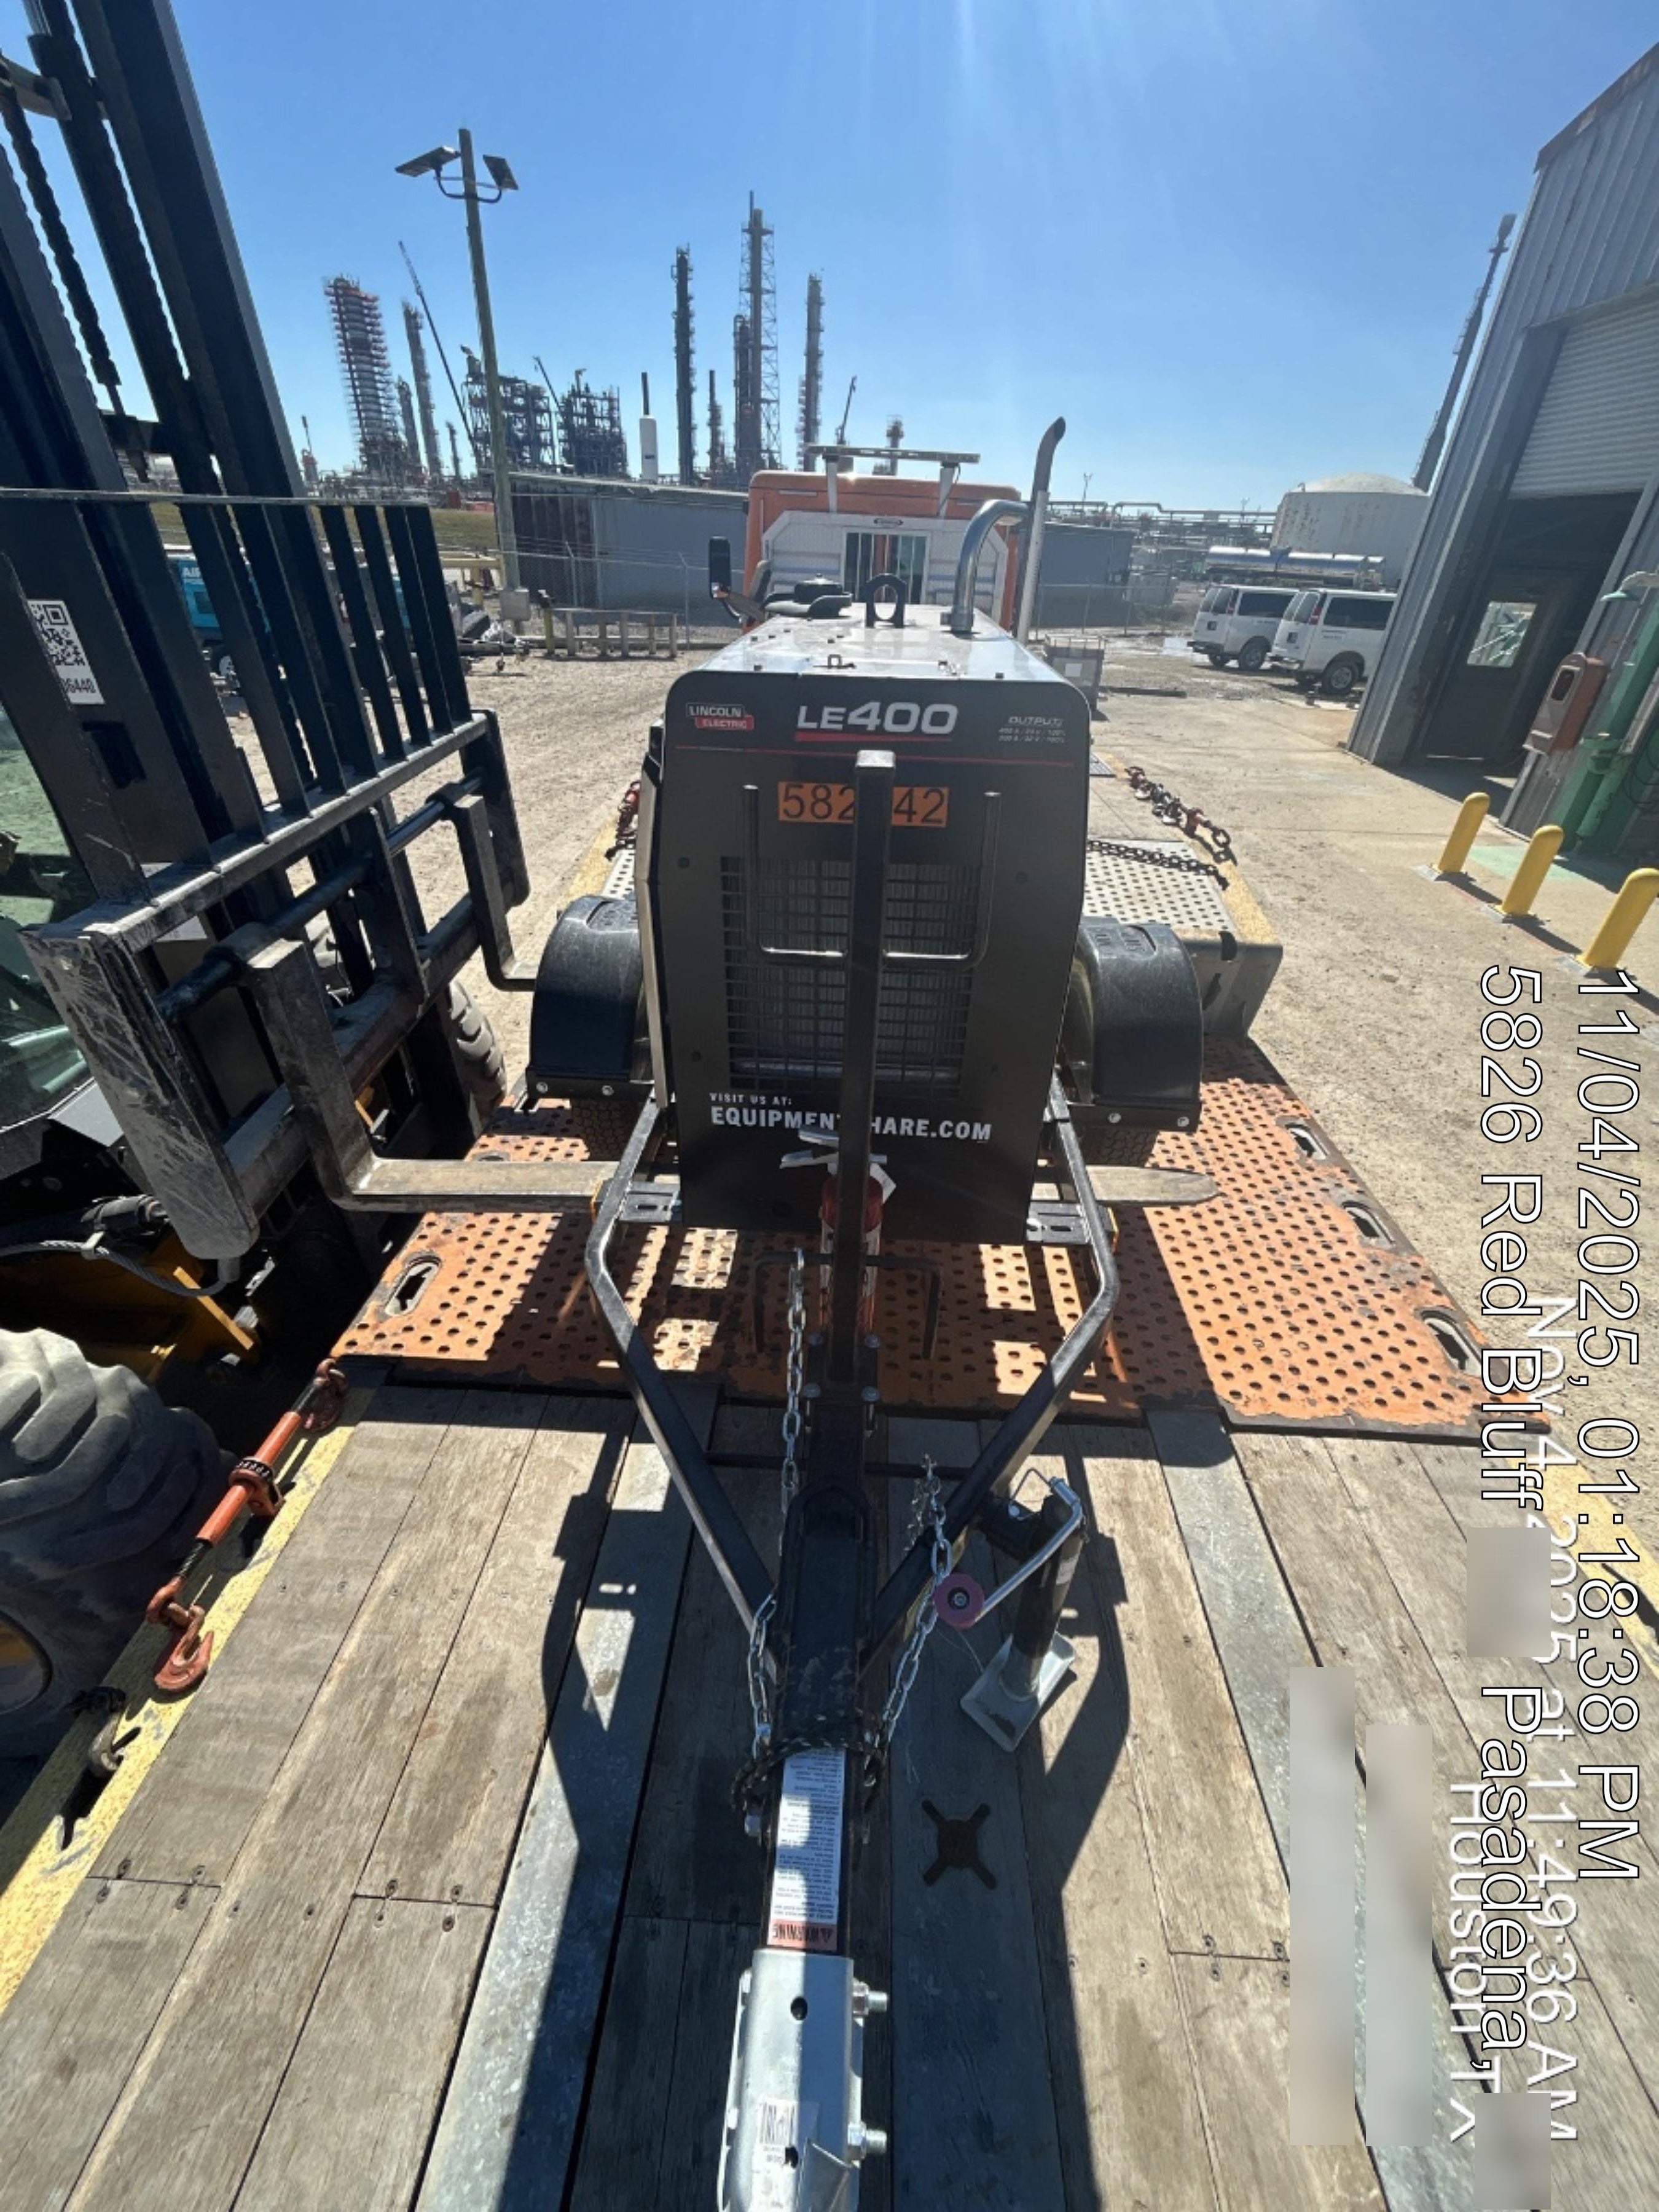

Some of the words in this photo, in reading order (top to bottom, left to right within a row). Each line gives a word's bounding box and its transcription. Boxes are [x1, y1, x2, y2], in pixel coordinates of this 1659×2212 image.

[689, 705, 742, 718] LINCOLN
[798, 701, 959, 734] LE400
[783, 783, 946, 823] 58242
[709, 1092, 744, 1104] VISIT
[750, 1095, 766, 1105] US
[772, 1096, 792, 1106] AT:
[711, 1106, 992, 1140] EQUIPMENHARE.COM
